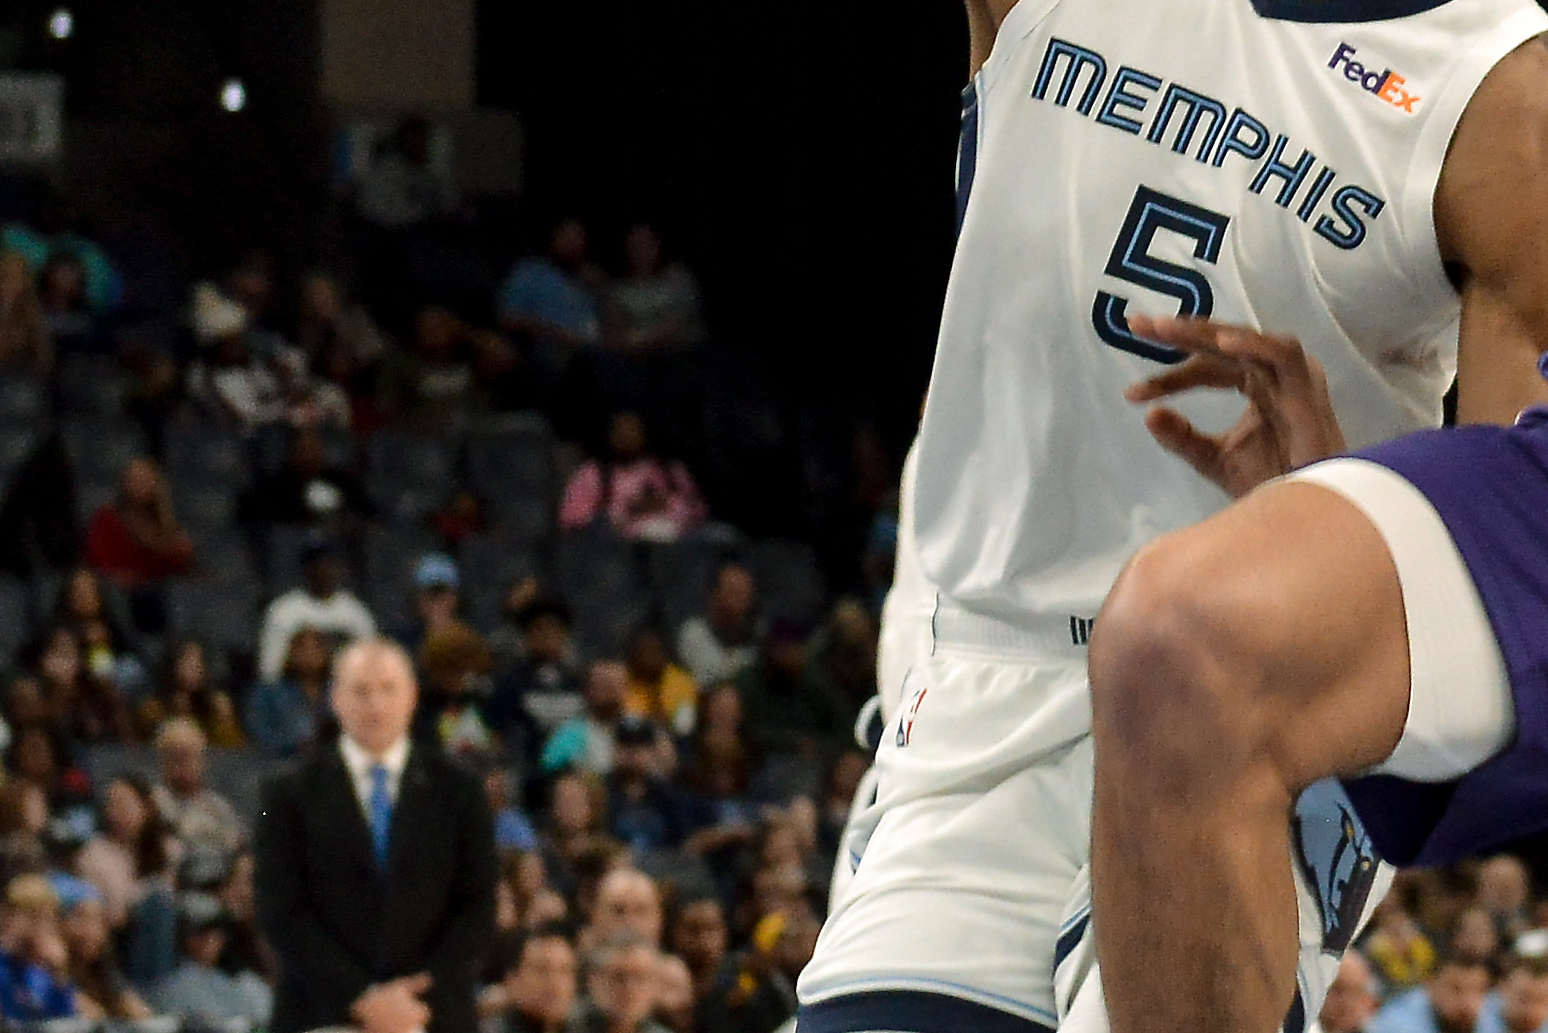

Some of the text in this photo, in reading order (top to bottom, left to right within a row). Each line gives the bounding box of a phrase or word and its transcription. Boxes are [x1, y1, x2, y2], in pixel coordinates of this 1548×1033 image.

[1031, 36, 1386, 250] MEMPHIS
[1326, 41, 1421, 114] FedEx
[1091, 183, 1231, 365] 5
